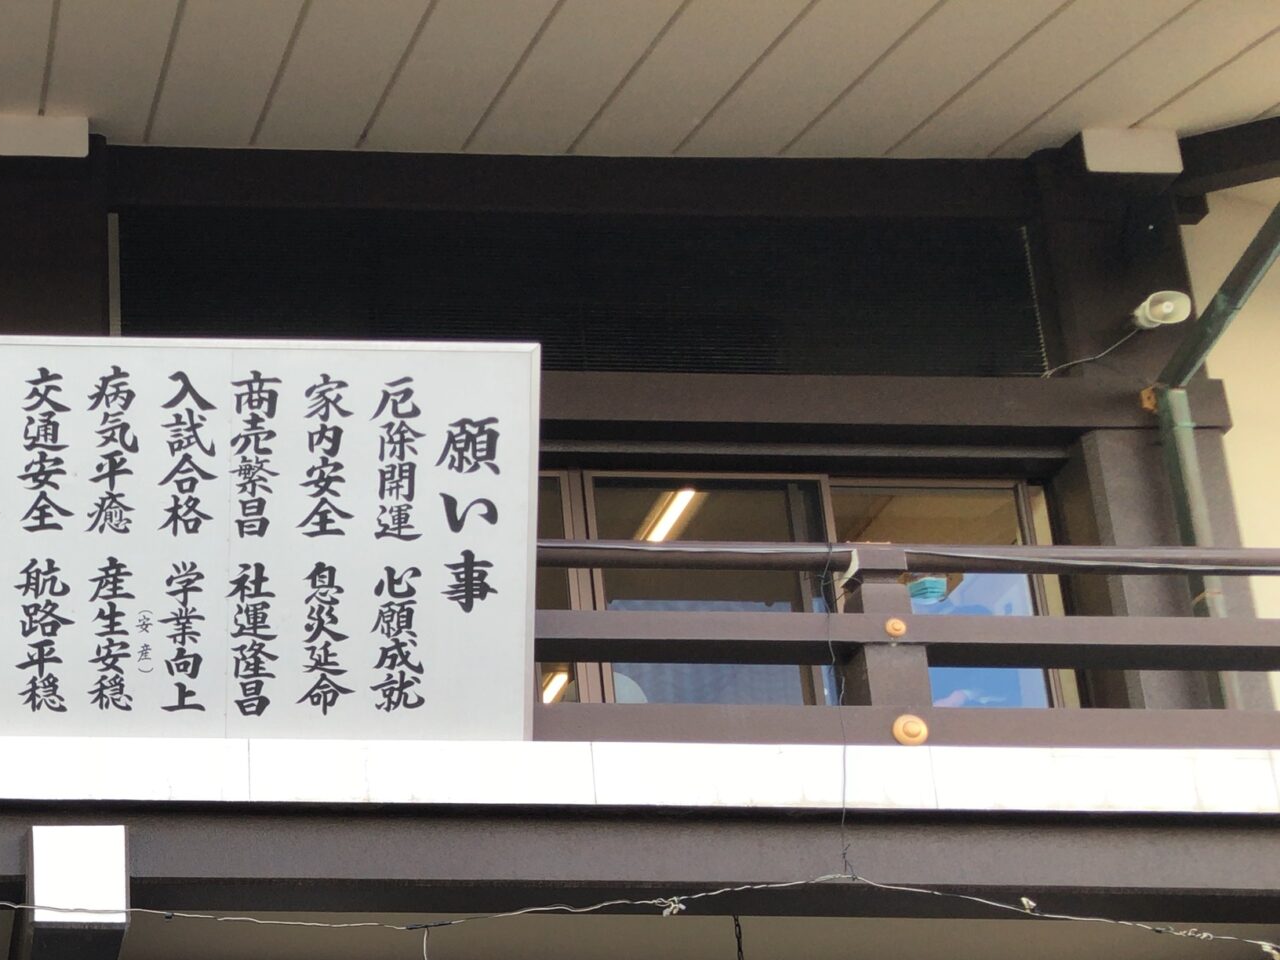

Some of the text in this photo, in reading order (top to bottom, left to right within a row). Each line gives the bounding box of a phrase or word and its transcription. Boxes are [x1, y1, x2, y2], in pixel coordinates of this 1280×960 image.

[16, 367, 75, 712] 交通安全 航路平穏
[86, 365, 139, 711] 病気平癒 産生安穏
[158, 370, 217, 712] 入試合格 学業向上
[225, 369, 281, 716] 商売繁昌 社運隆昌
[296, 374, 355, 715] 家内安全 息災延命
[370, 376, 426, 710] 厄除開運 心願成就
[436, 416, 500, 612] 願い事
